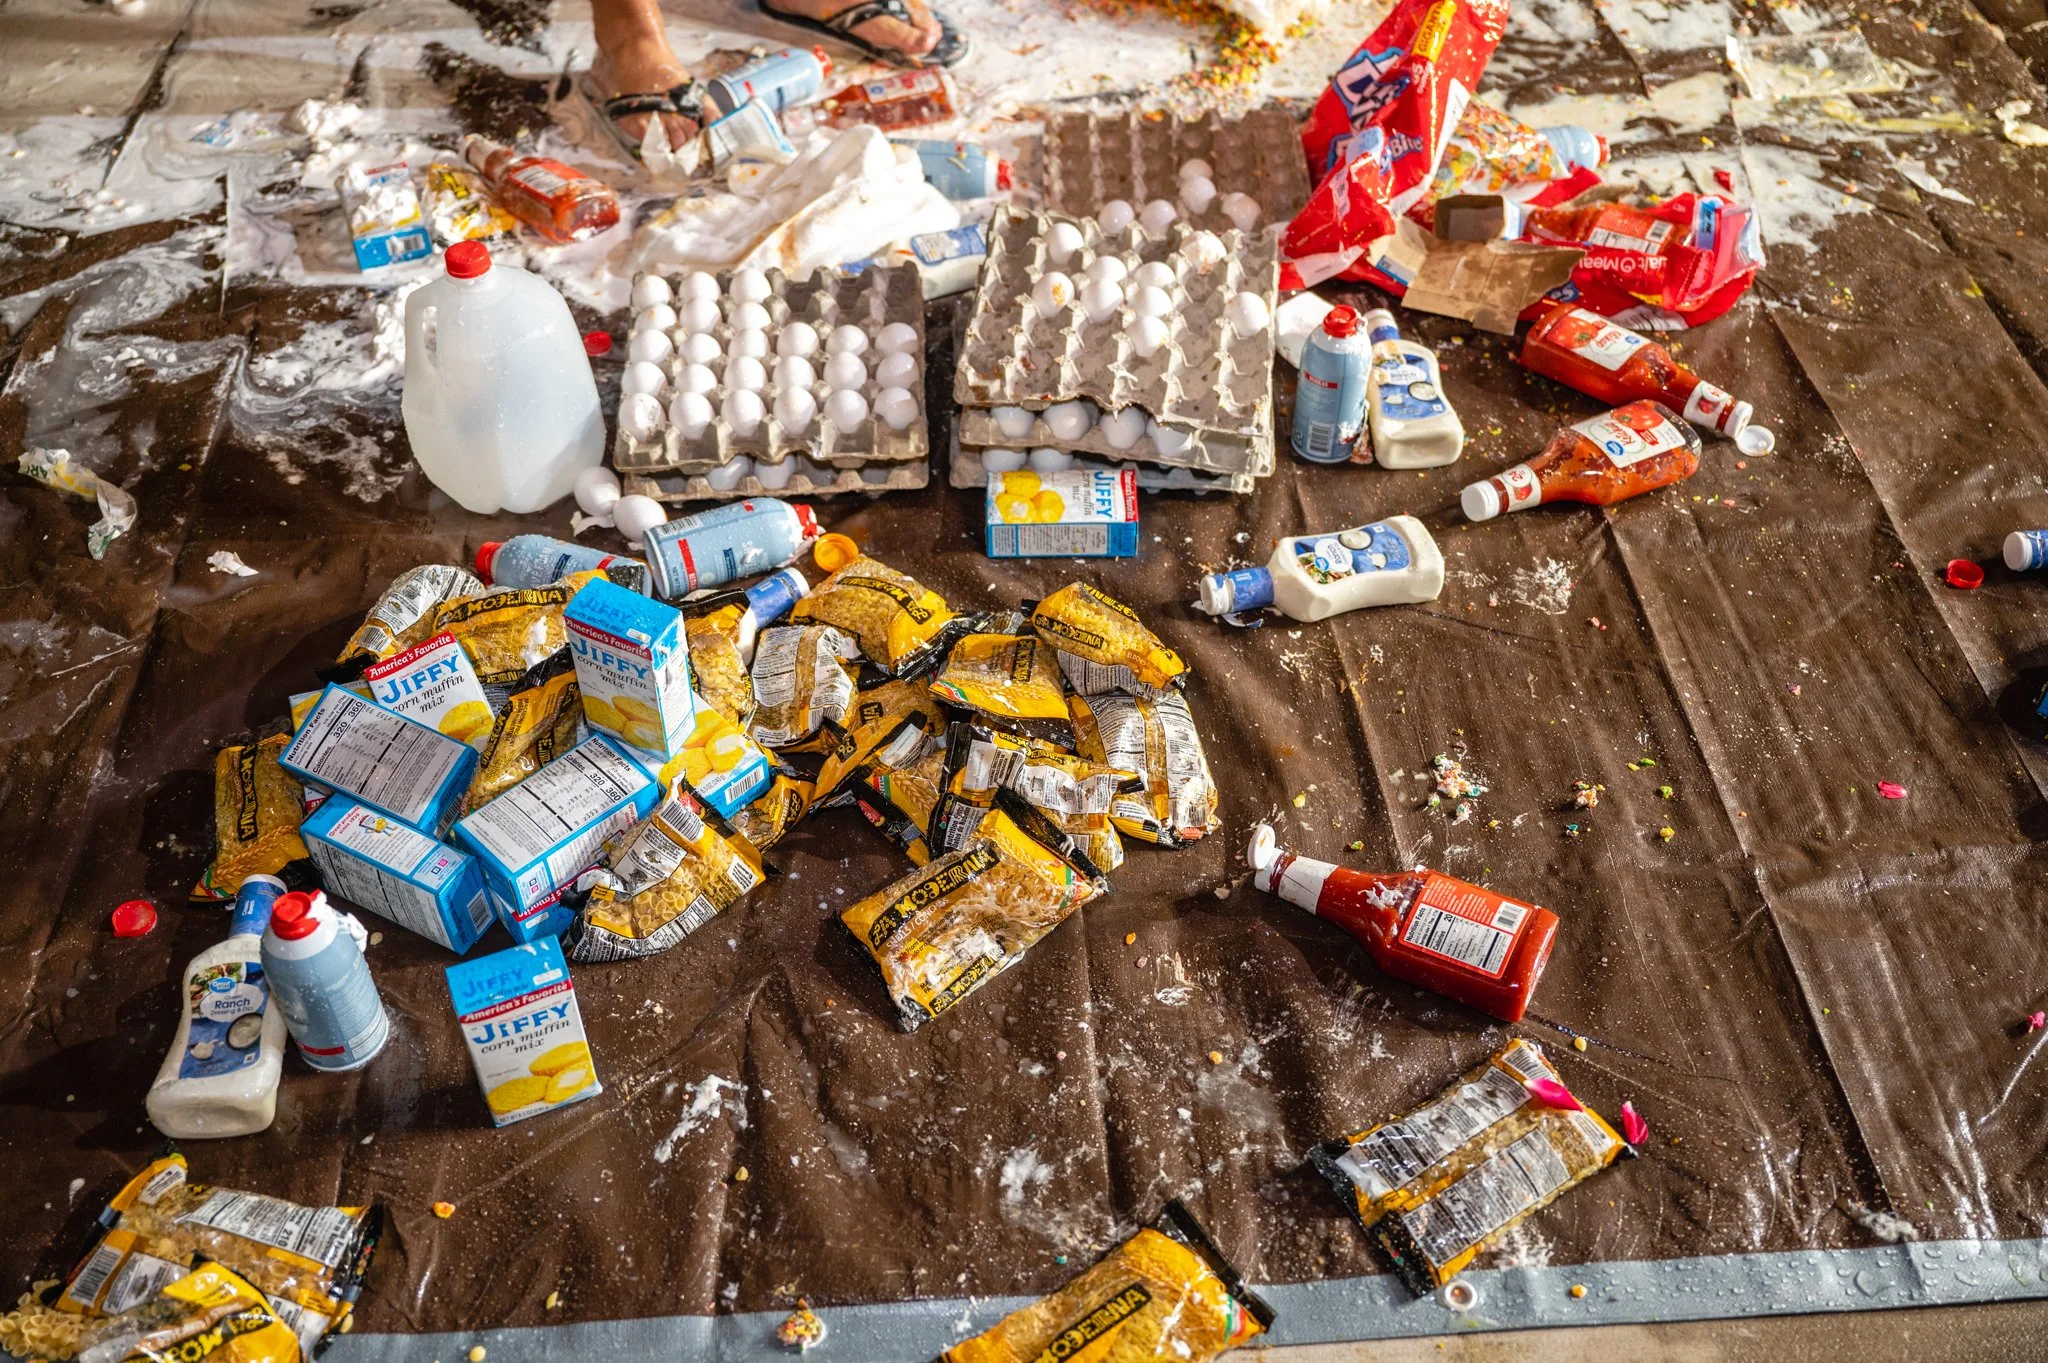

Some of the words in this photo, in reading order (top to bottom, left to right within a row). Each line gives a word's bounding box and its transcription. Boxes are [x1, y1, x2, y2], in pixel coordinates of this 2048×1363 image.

[566, 618, 609, 643] America's
[610, 638, 649, 658] Favorite
[370, 652, 414, 678] America's
[414, 635, 451, 658] Favorite
[577, 655, 603, 672] corn
[605, 668, 648, 690] muffin
[392, 698, 420, 713] corn
[422, 674, 464, 700] muffin
[600, 675, 626, 689] mix
[420, 695, 445, 713] mix
[286, 727, 312, 763] Nutrition
[311, 707, 326, 730] Facts
[312, 746, 332, 774] Calories
[333, 721, 348, 739] 320
[347, 701, 363, 718] 360
[591, 736, 616, 760] Nutrition
[614, 756, 632, 772] Facts
[566, 754, 586, 771] Calories
[589, 772, 606, 787] 320
[605, 787, 621, 801] 360
[873, 915, 897, 946] LA
[894, 849, 996, 918] MODERNA
[1405, 918, 1421, 942] Nutrition
[1416, 906, 1427, 922] Facts
[1433, 930, 1446, 952] Calories
[1443, 913, 1453, 923] 20
[903, 939, 921, 954] From
[213, 996, 251, 1010] Ranch
[464, 998, 522, 1022] America's
[522, 984, 568, 1003] Favorite
[481, 1038, 516, 1054] corn
[519, 1019, 571, 1043] muffin
[514, 1037, 545, 1054] mix
[276, 1227, 293, 1248] 210
